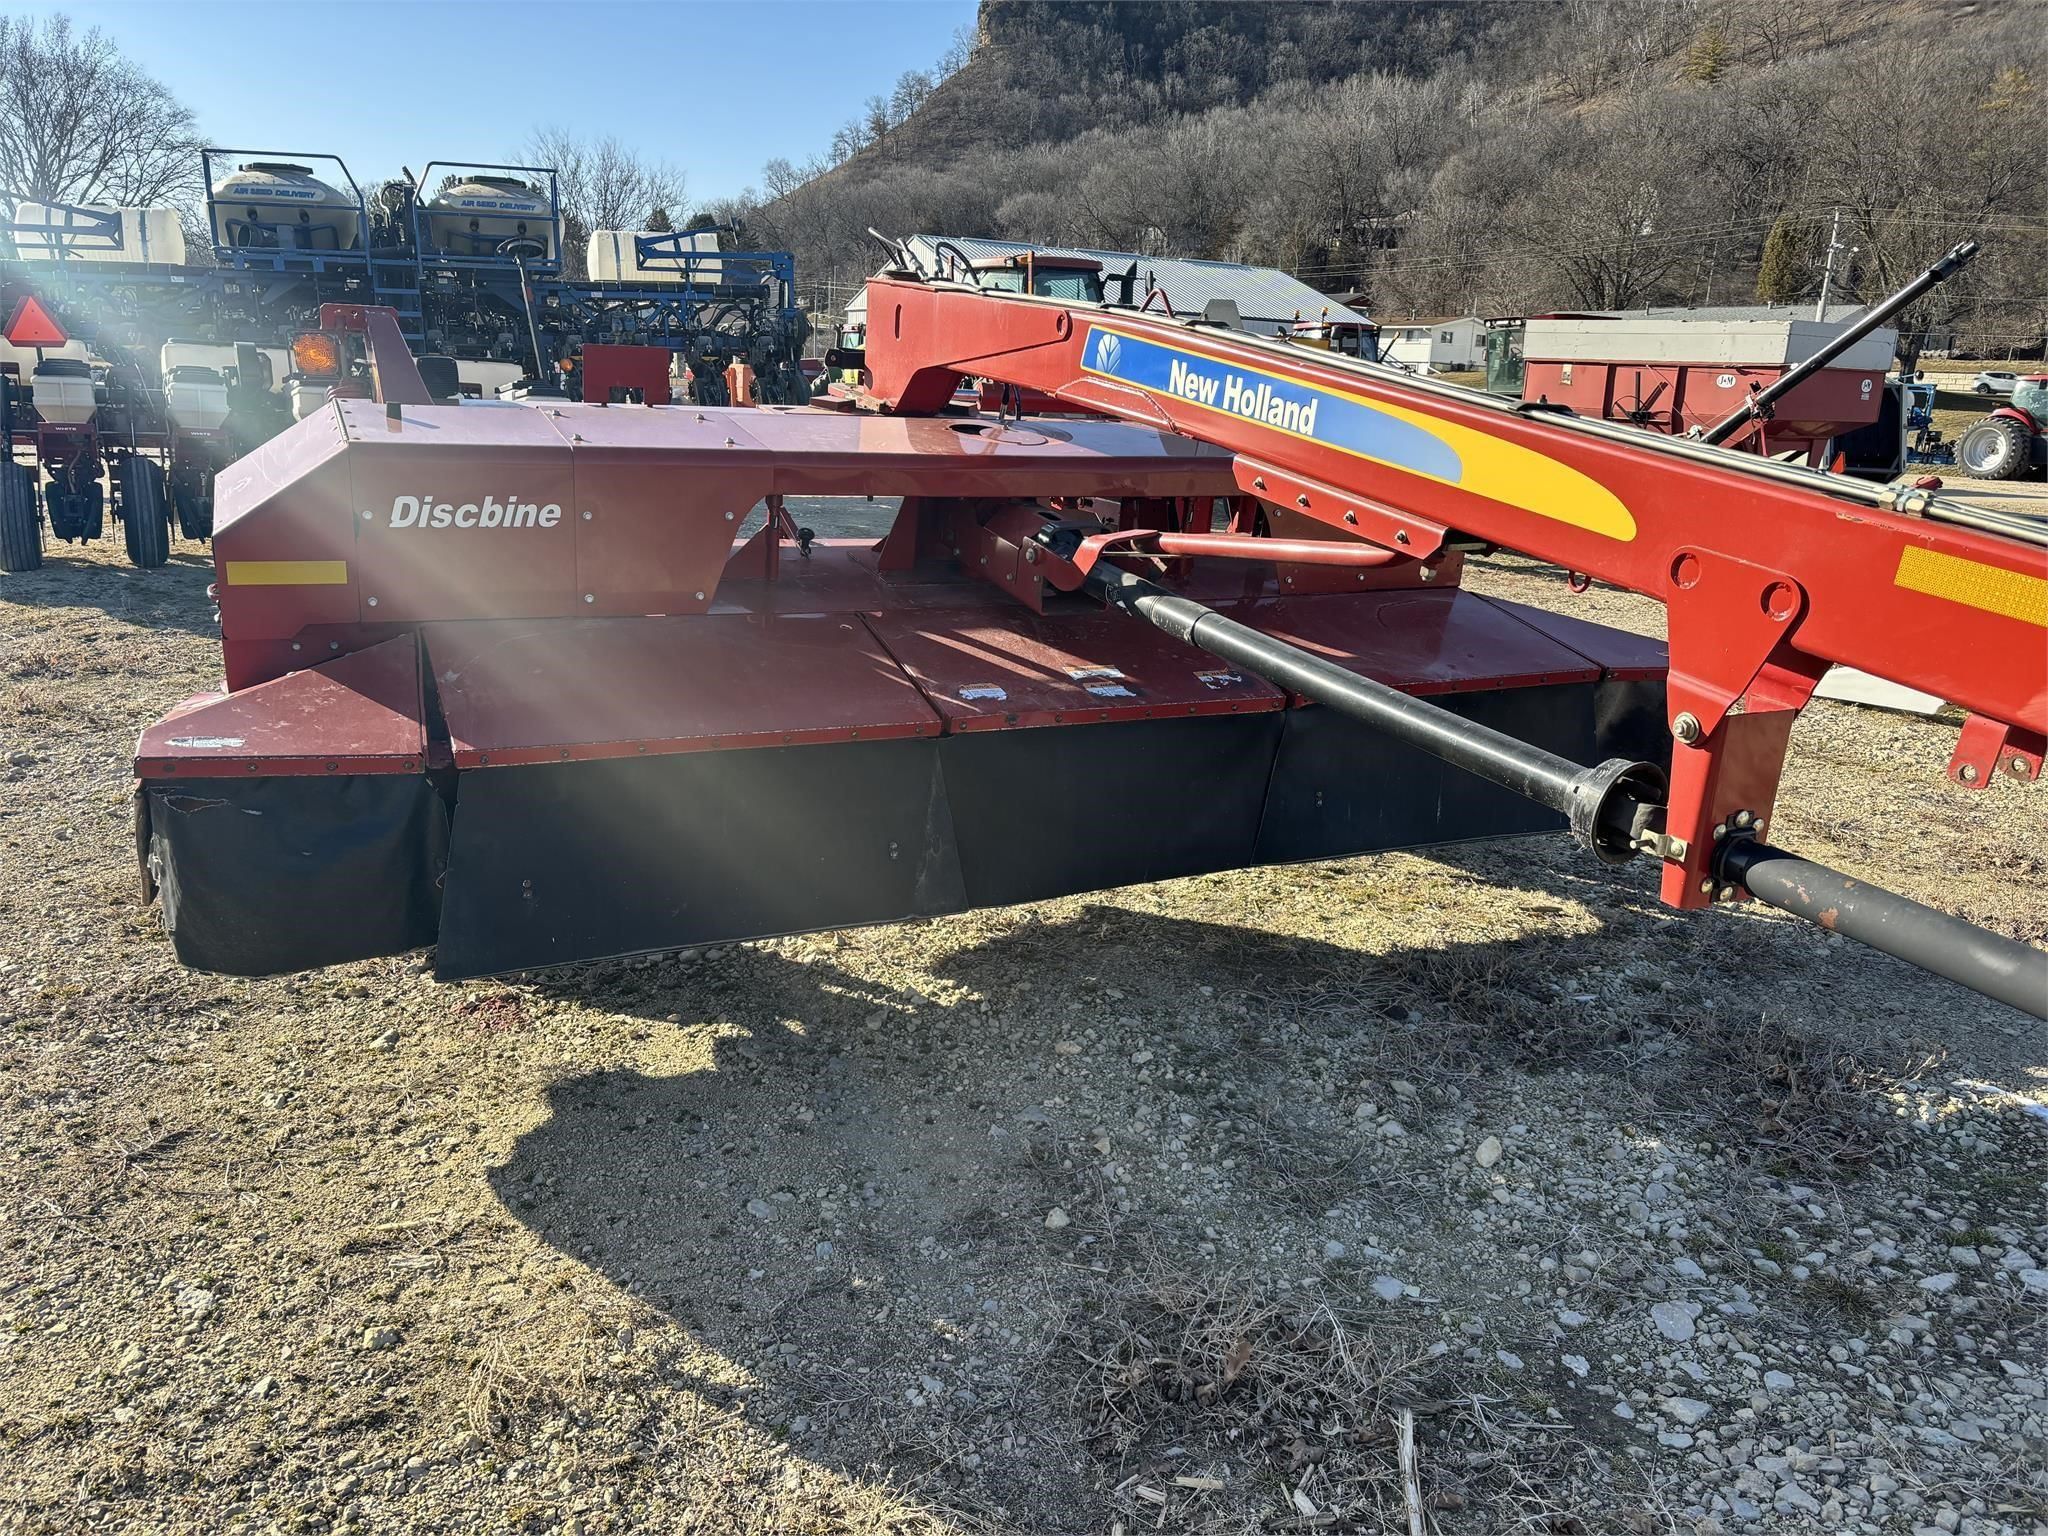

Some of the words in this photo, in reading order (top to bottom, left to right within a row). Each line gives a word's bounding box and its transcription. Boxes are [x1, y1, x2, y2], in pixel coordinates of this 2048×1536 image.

[233, 186, 249, 195] AIR
[275, 190, 316, 199] DELIVERY
[499, 202, 537, 211] DELIVERY
[1168, 358, 1220, 403] New
[1222, 374, 1318, 437] Holland
[388, 495, 562, 528] Discbine
